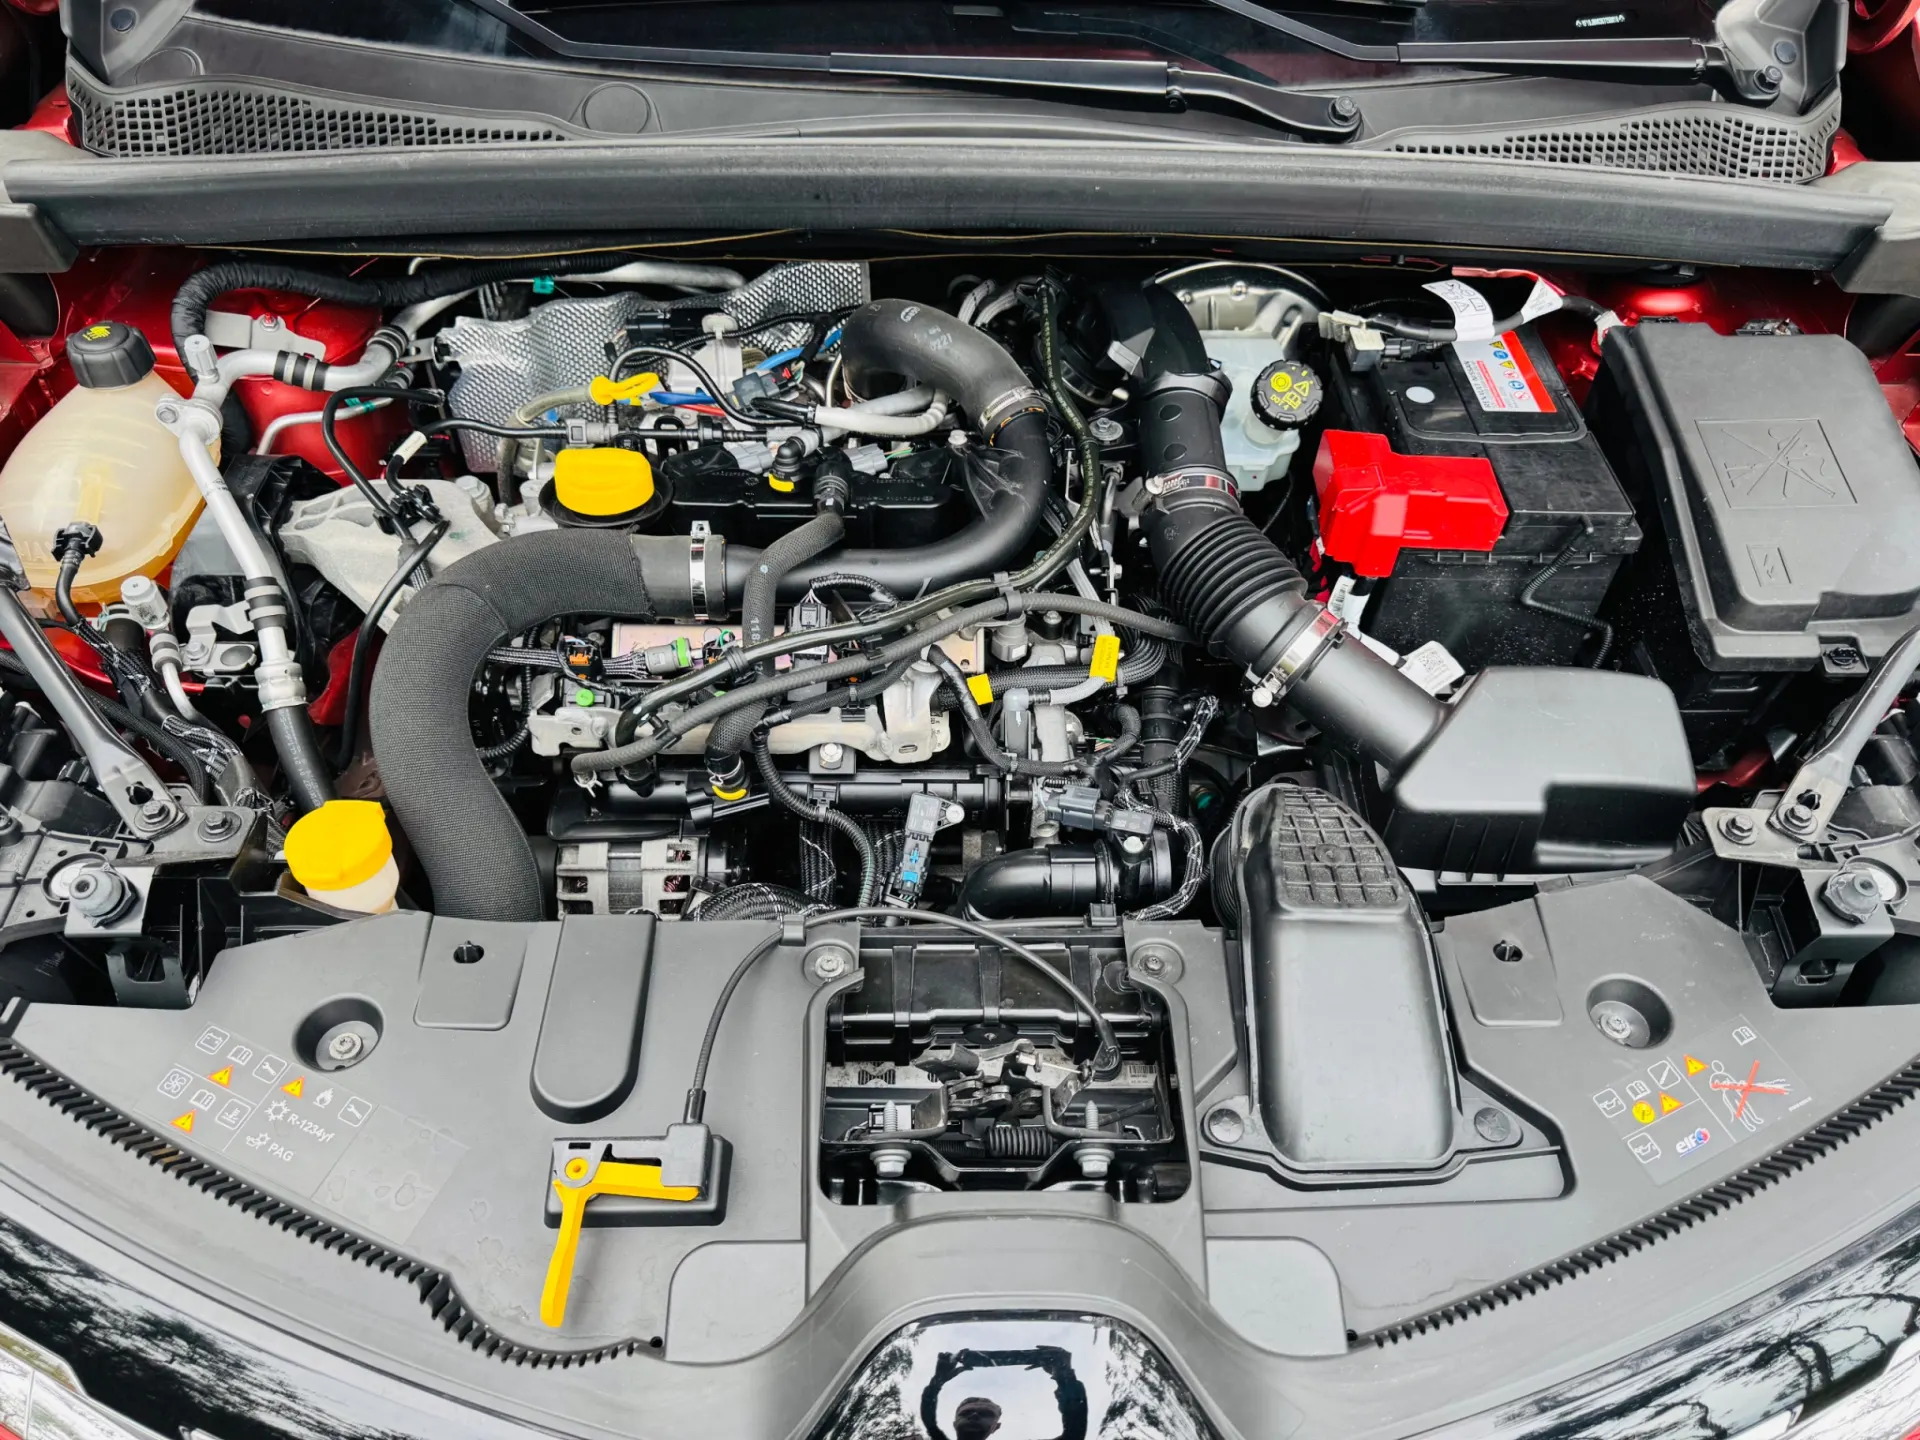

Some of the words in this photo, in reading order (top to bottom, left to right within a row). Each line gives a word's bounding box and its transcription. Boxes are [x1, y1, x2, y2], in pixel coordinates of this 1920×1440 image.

[1271, 394, 1284, 406] DOT
[287, 1113, 335, 1142] R-1234yf
[267, 1142, 294, 1161] PAG
